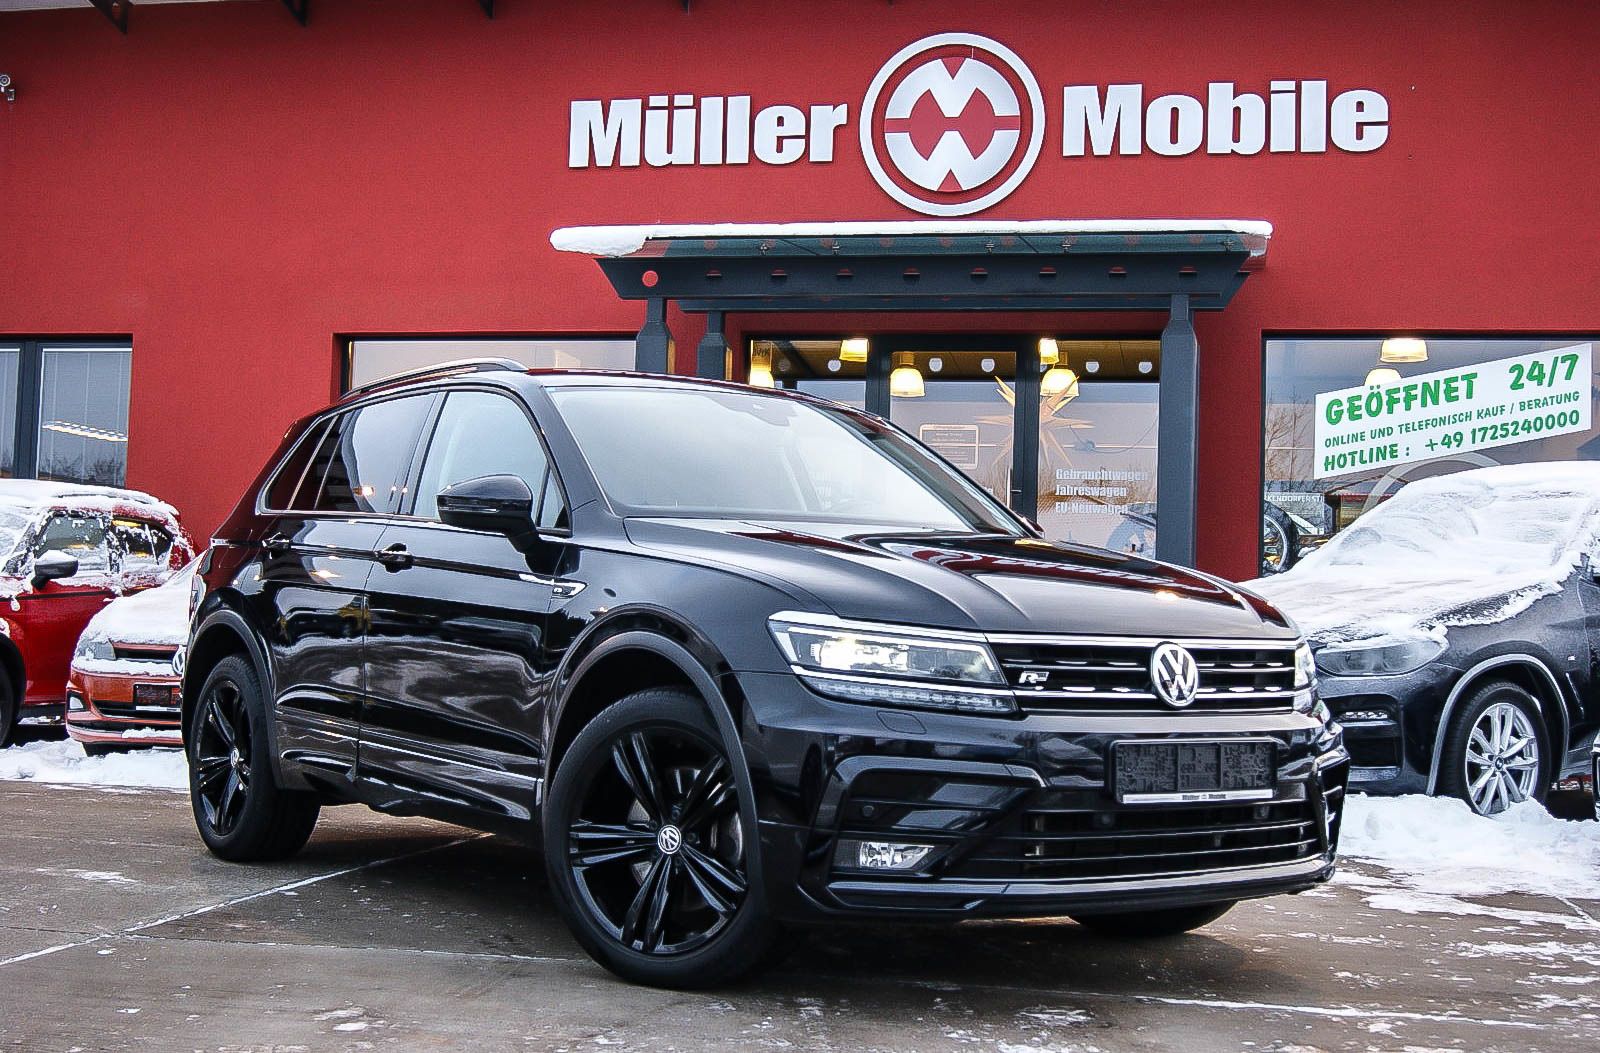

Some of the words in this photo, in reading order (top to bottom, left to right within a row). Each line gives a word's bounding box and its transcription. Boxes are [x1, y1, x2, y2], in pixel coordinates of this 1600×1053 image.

[569, 94, 847, 168] Müller
[1062, 79, 1389, 157] Mobile
[1324, 431, 1366, 448] ONLINE
[1370, 426, 1394, 440] UND
[1398, 411, 1472, 435] TELEFONISCH
[1476, 404, 1506, 420] KAUF
[1519, 391, 1580, 412] BERATUNG
[1325, 372, 1478, 426] GEÖFFNET
[1508, 353, 1579, 391] 24/7
[1323, 443, 1399, 472] HOTLINE
[1424, 431, 1464, 452] +49
[1470, 409, 1580, 445] 1725240000
[1055, 468, 1148, 482] Gebrauchtwagen
[1055, 484, 1127, 498] Jahreswagen
